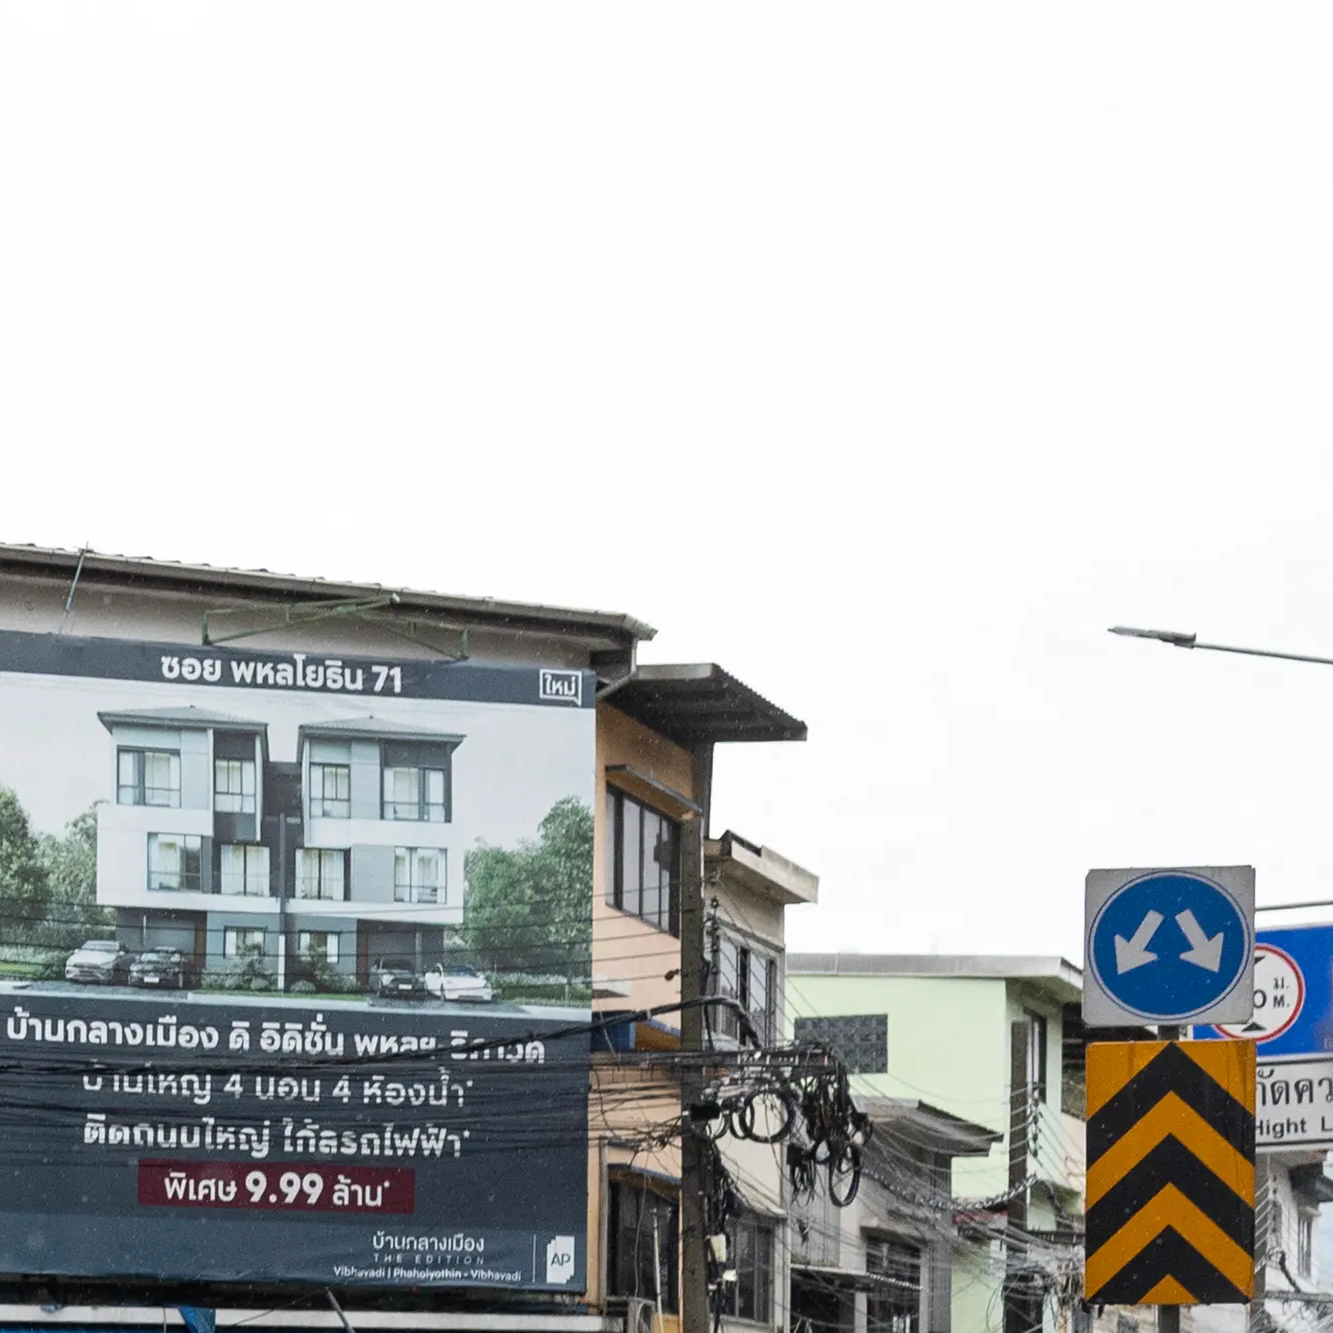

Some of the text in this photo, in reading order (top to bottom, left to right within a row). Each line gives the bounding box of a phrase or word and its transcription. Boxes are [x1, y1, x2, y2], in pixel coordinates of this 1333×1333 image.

[161, 653, 402, 693] ซอย พหลโยธิน 71
[544, 673, 576, 696] ใหม่
[6, 1006, 220, 1050] บ้านกลางเมือง
[229, 1020, 250, 1051] ดิ
[259, 1013, 344, 1056] อิดิชั่น
[83, 1059, 212, 1105] บ้านใหญ
[223, 1073, 244, 1100] 4
[255, 1074, 321, 1102] นอน
[332, 1075, 352, 1103] 4
[164, 1171, 237, 1202] พิเศษ
[245, 1170, 324, 1205] 9.99
[372, 1231, 484, 1252] บ้านกลางเมือง
[373, 1253, 485, 1265] THE EDITION
[550, 1253, 571, 1267] AP
[470, 1269, 522, 1282] Vibhavadi
